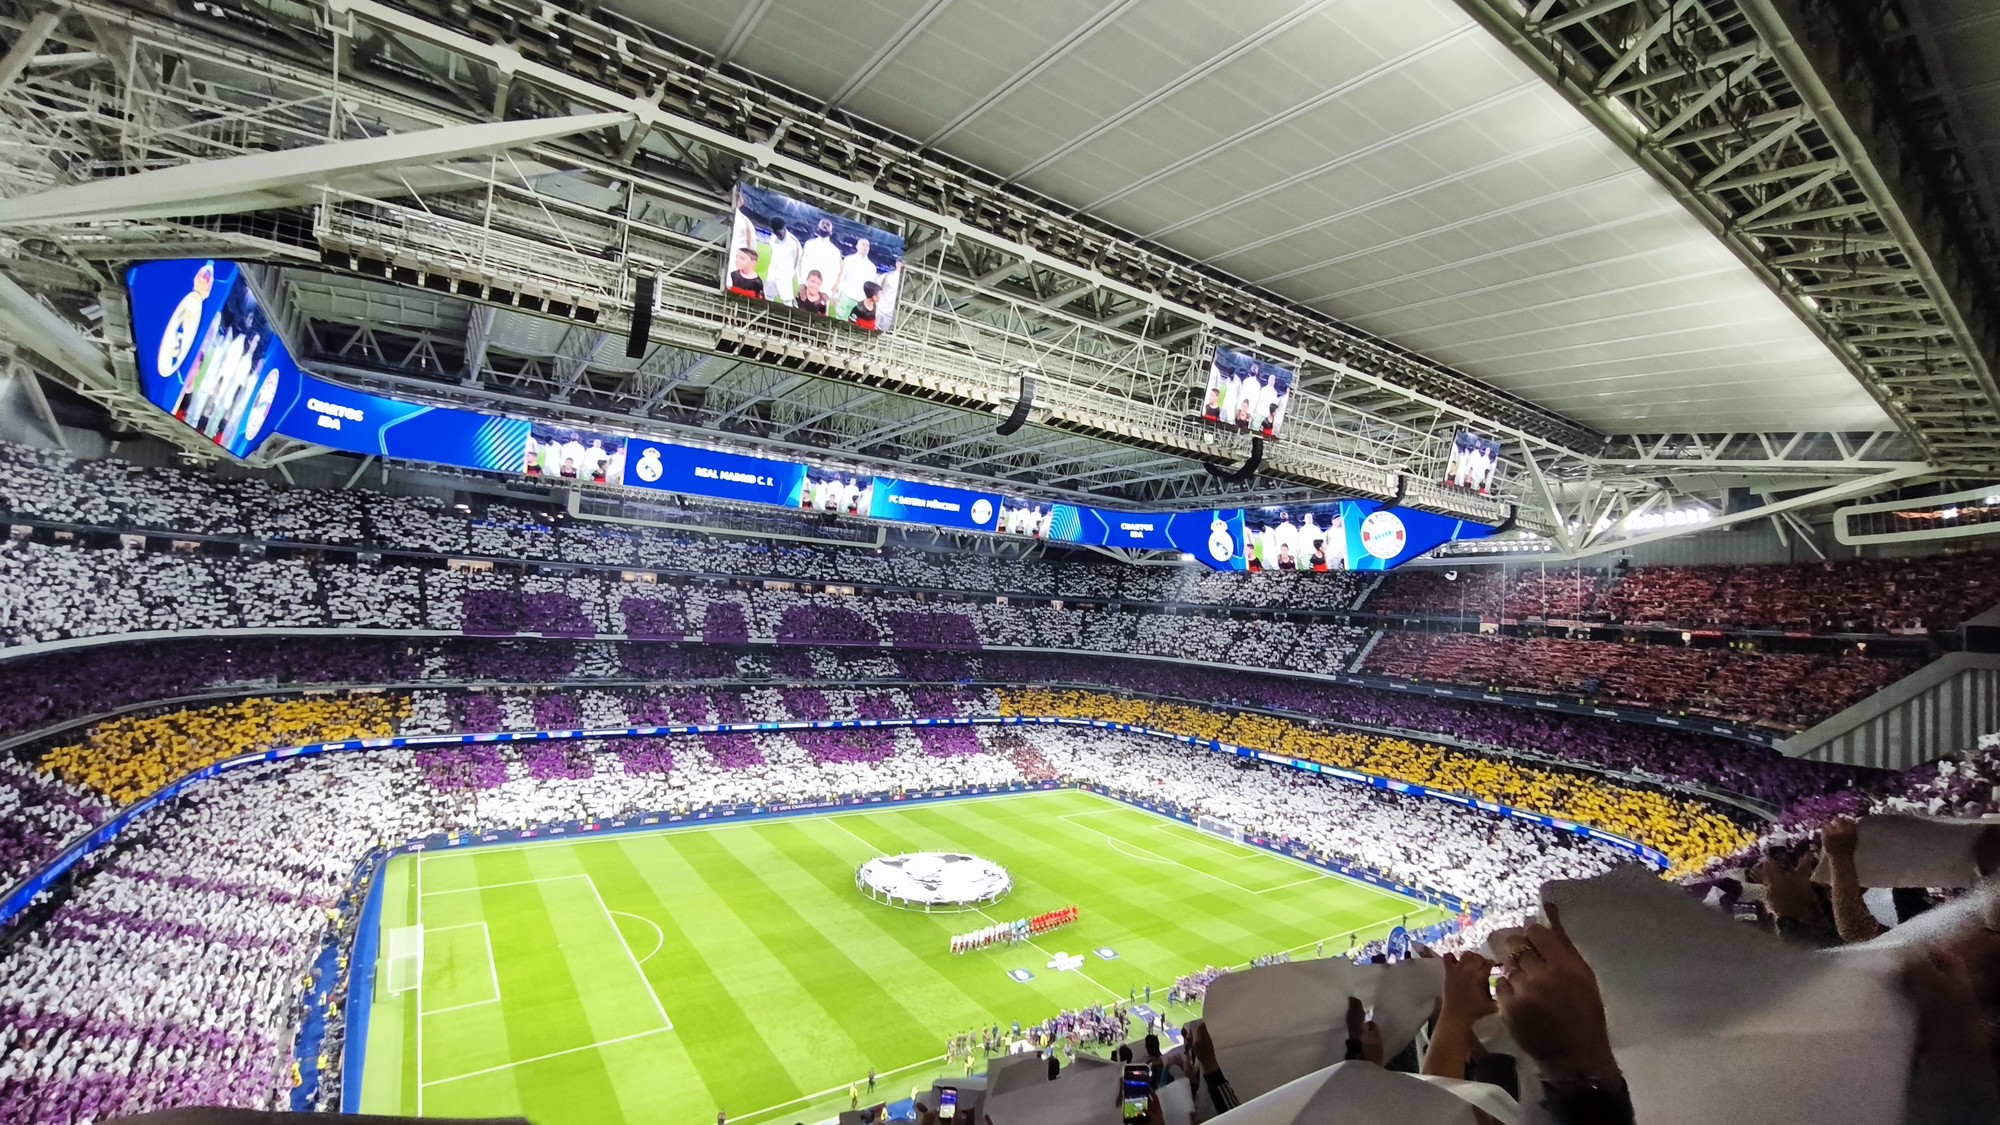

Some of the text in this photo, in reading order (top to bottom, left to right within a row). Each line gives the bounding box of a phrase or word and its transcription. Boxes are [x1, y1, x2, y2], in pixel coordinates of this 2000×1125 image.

[307, 398, 364, 422] CUARTOS
[695, 466, 719, 479] REAL
[720, 470, 757, 484] MADRID
[888, 494, 899, 504] FC
[898, 495, 927, 508] BAYERN
[791, 802, 817, 810] CHAMPIONS
[817, 800, 834, 808] LEAGUE
[550, 827, 565, 835] UEFA
[482, 834, 498, 842] UEFA
